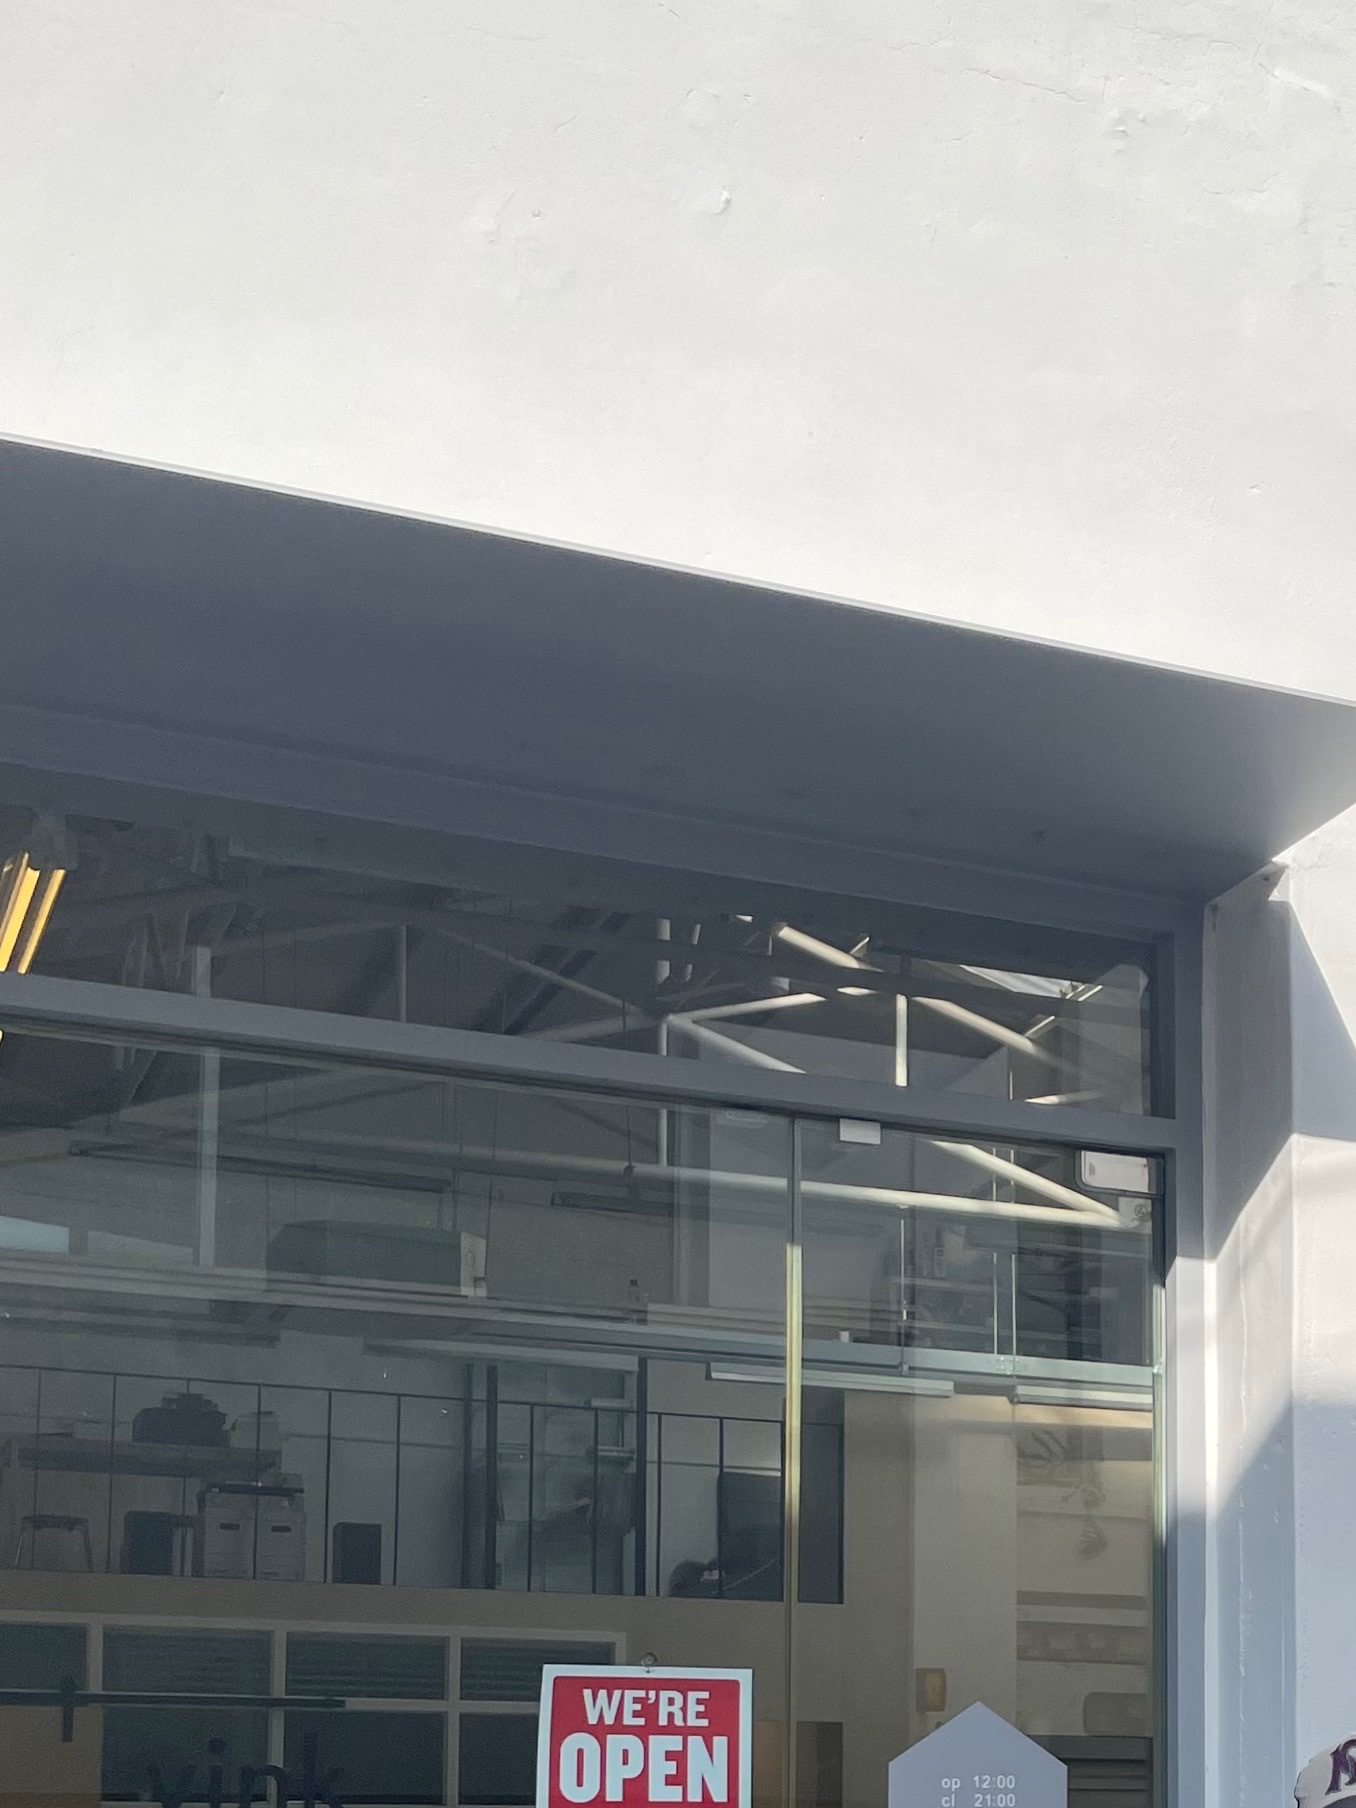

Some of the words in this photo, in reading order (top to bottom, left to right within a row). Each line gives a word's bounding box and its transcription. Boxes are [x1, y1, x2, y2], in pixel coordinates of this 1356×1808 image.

[583, 1689, 711, 1727] WE'RE
[559, 1731, 729, 1804] OPEN
[941, 1777, 961, 1792] op
[973, 1775, 1016, 1789] 12:00
[941, 1793, 956, 1807] cl
[974, 1793, 1016, 1807] 21:00
